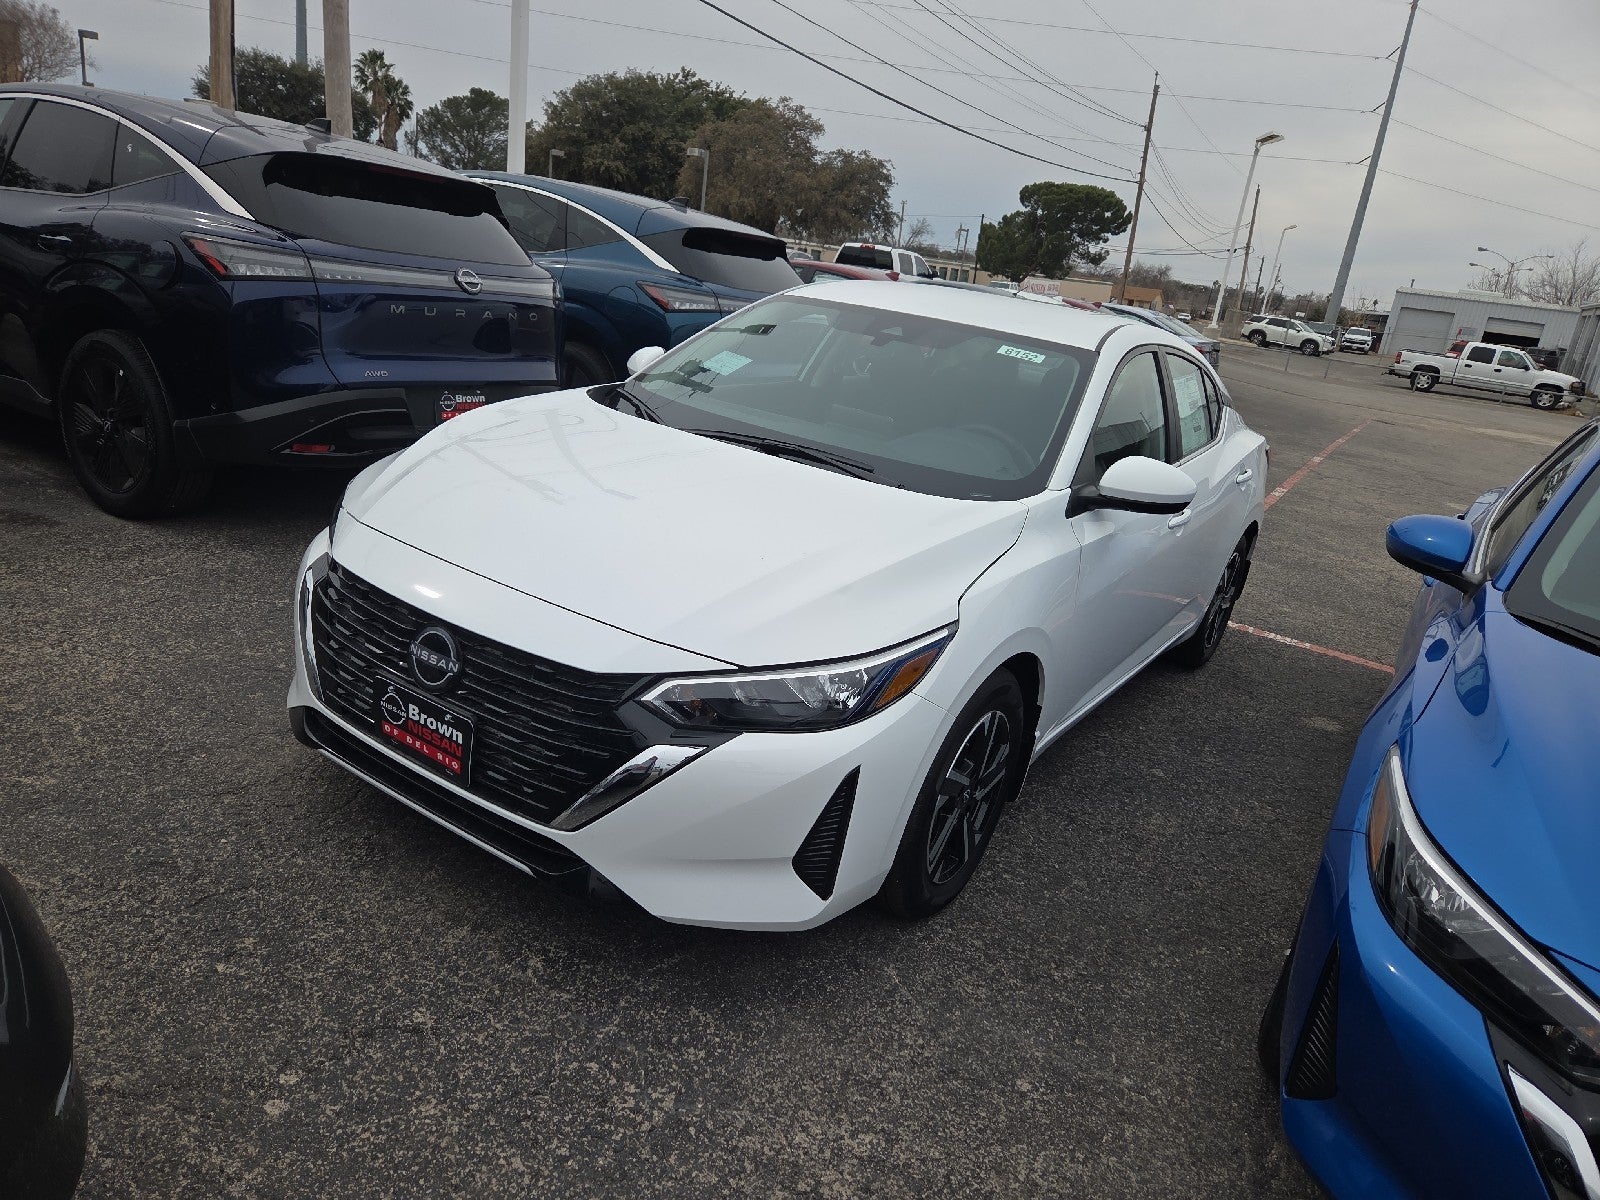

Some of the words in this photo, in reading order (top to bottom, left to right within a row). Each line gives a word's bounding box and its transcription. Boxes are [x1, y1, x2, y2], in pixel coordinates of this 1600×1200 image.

[390, 304, 538, 321] MURANO
[455, 394, 486, 403] Brown
[410, 643, 459, 673] NISSAN
[380, 700, 407, 719] NISSAN
[408, 703, 463, 745] Brown
[384, 724, 399, 736] OF
[406, 735, 429, 754] DEL
[437, 752, 459, 769] RIO
[407, 719, 462, 757] NISSAN
